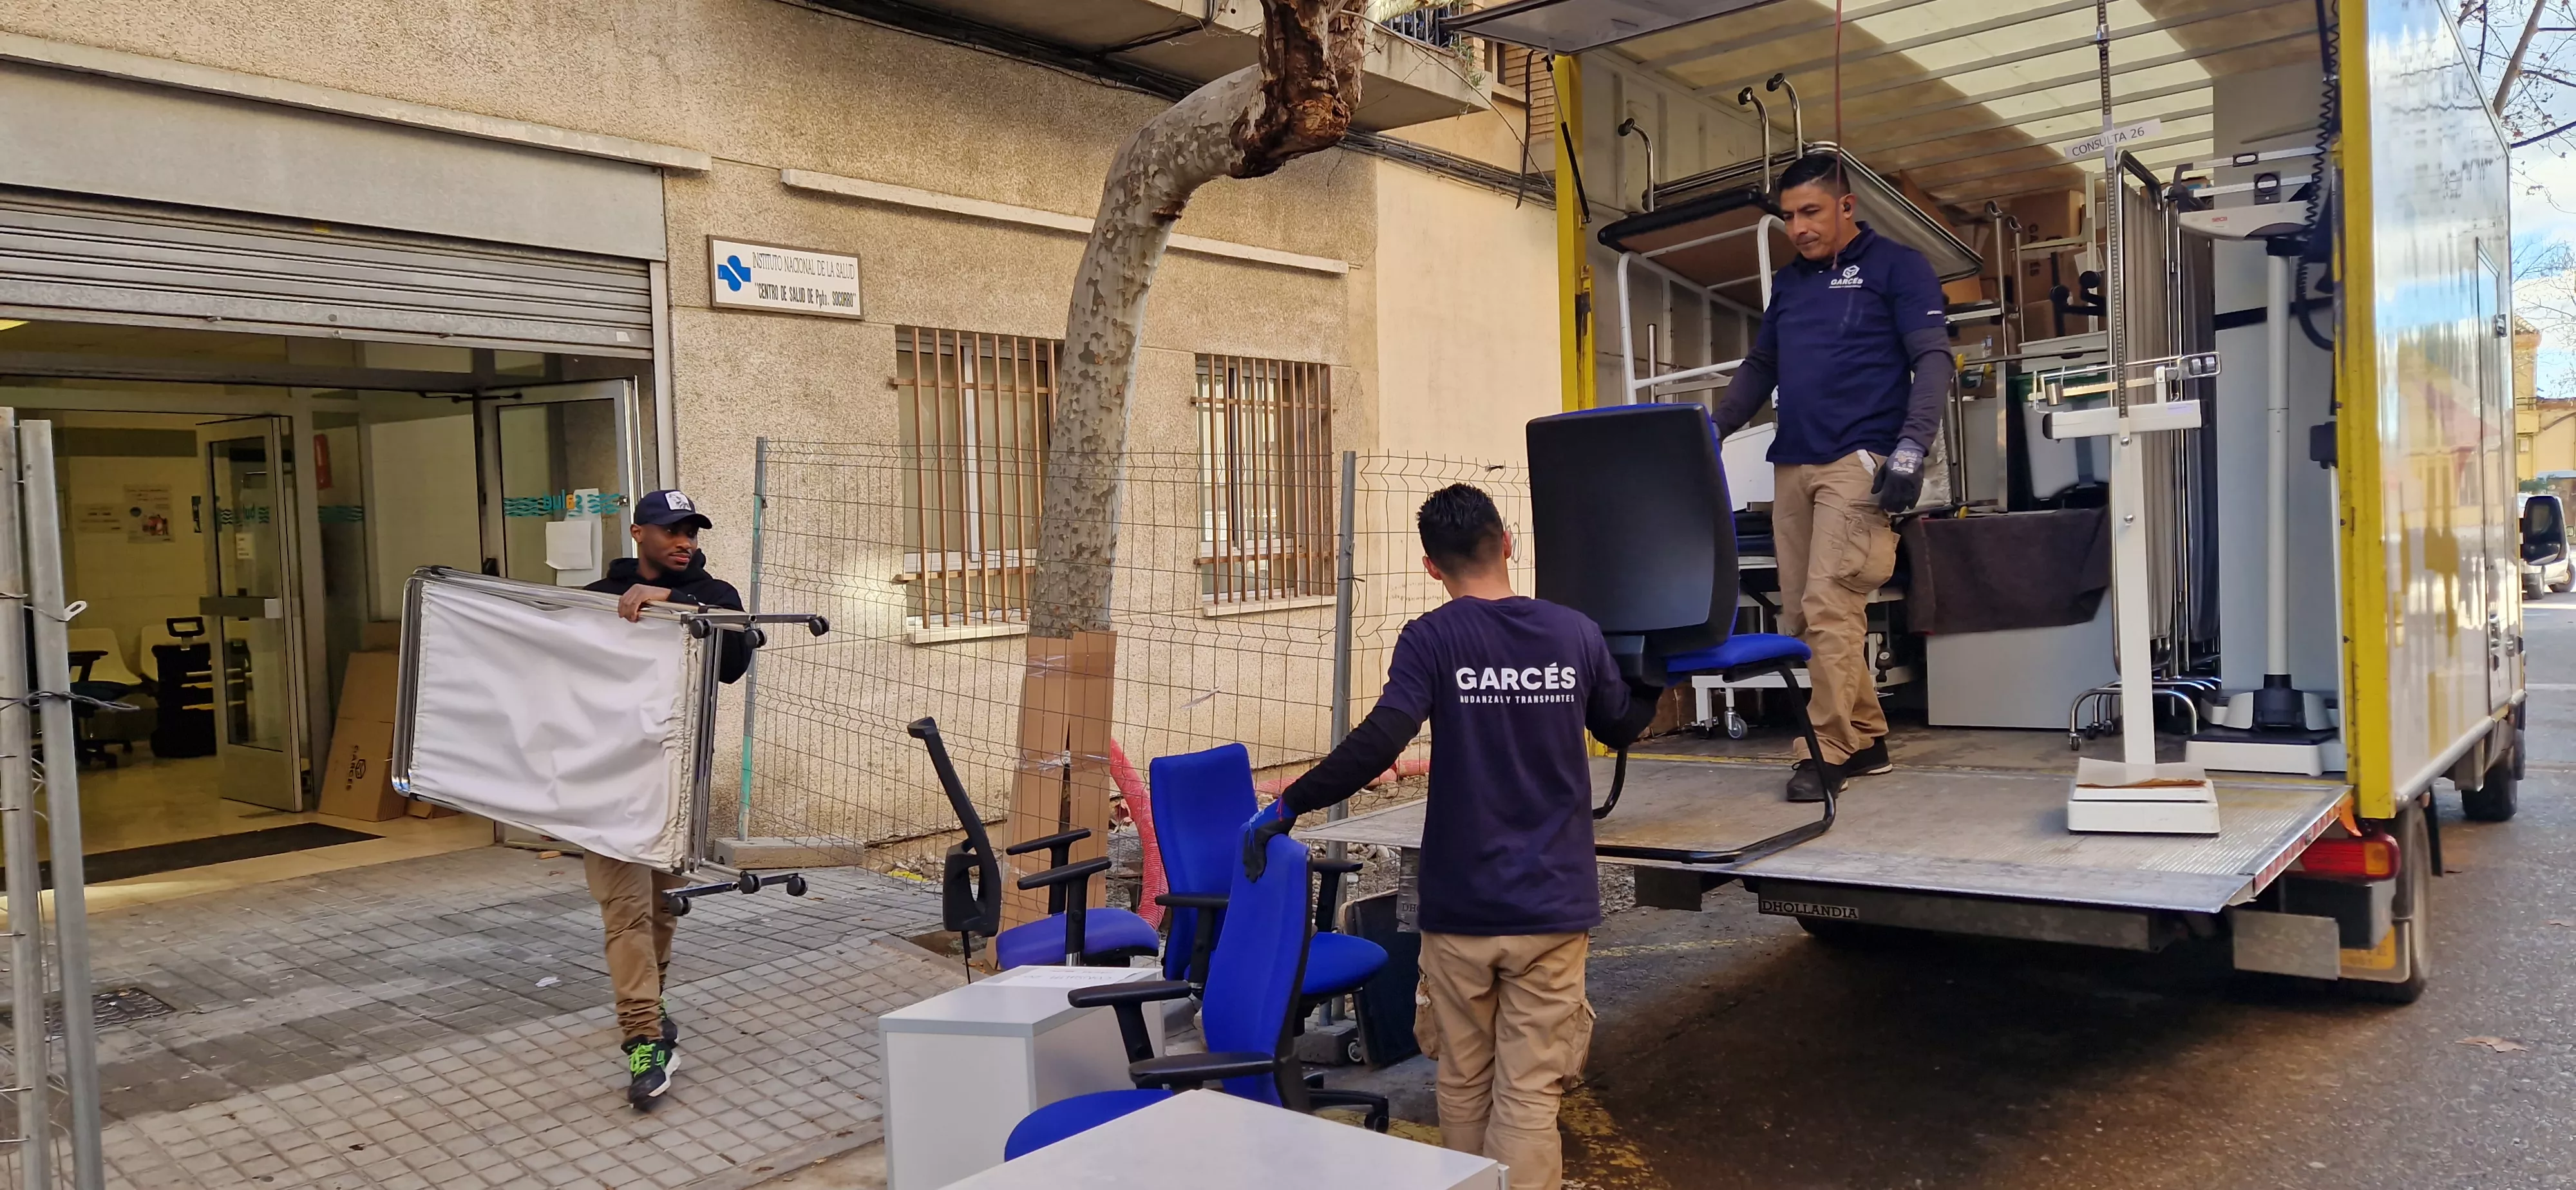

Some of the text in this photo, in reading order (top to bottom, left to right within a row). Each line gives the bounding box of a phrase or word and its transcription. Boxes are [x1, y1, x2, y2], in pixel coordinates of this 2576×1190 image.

[2072, 127, 2145, 156] CONSULTA 26
[752, 252, 855, 279] INSTITUTO NACIONAL DE LA SALUD
[781, 285, 787, 301] DE
[789, 286, 806, 303] SALUD
[807, 287, 813, 304] DE
[1455, 662, 1576, 690] GARCÉS
[1506, 695, 1511, 704] Y
[1515, 695, 1575, 704] TRANSPORTES
[1402, 903, 1419, 912] DH
[1762, 901, 1858, 919] DHOLLANDIA
